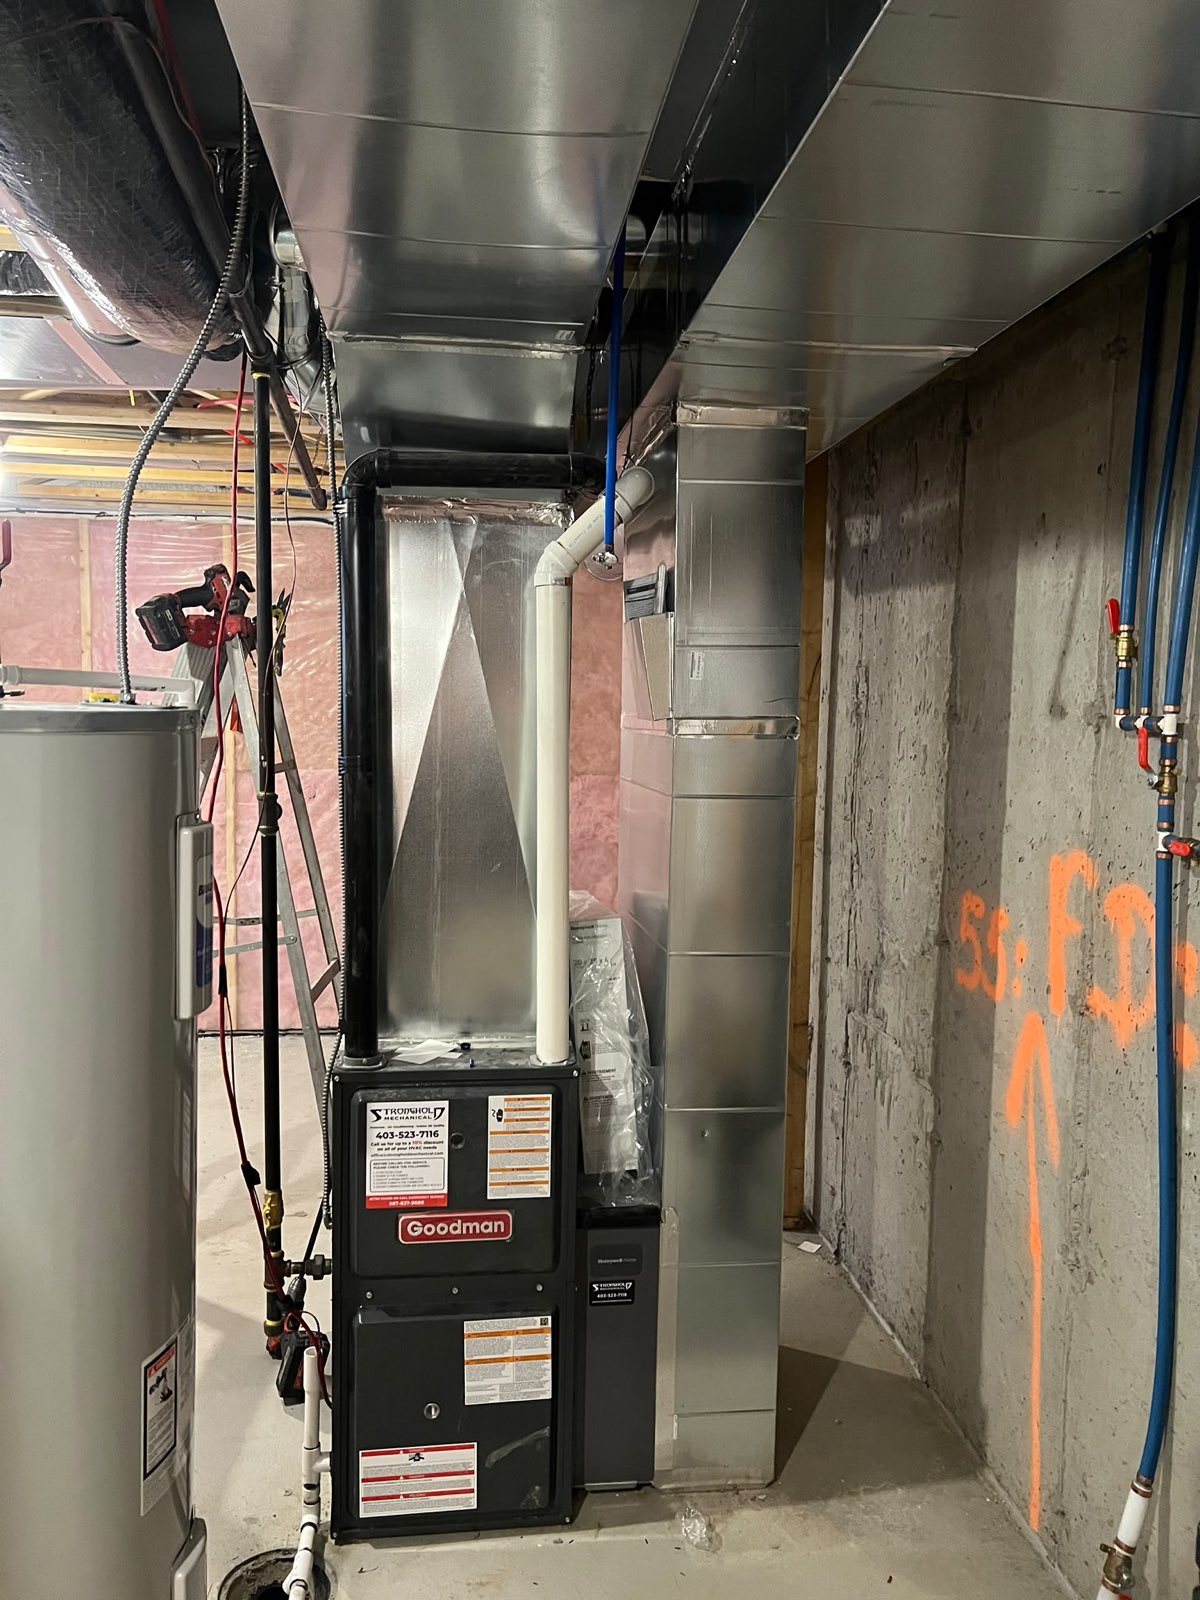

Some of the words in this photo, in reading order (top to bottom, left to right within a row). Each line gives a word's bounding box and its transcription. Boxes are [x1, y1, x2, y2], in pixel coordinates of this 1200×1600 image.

[370, 1107, 446, 1122] STRONGHOLD
[376, 1130, 439, 1139] 403-523-7116
[407, 1219, 504, 1237] Goodman
